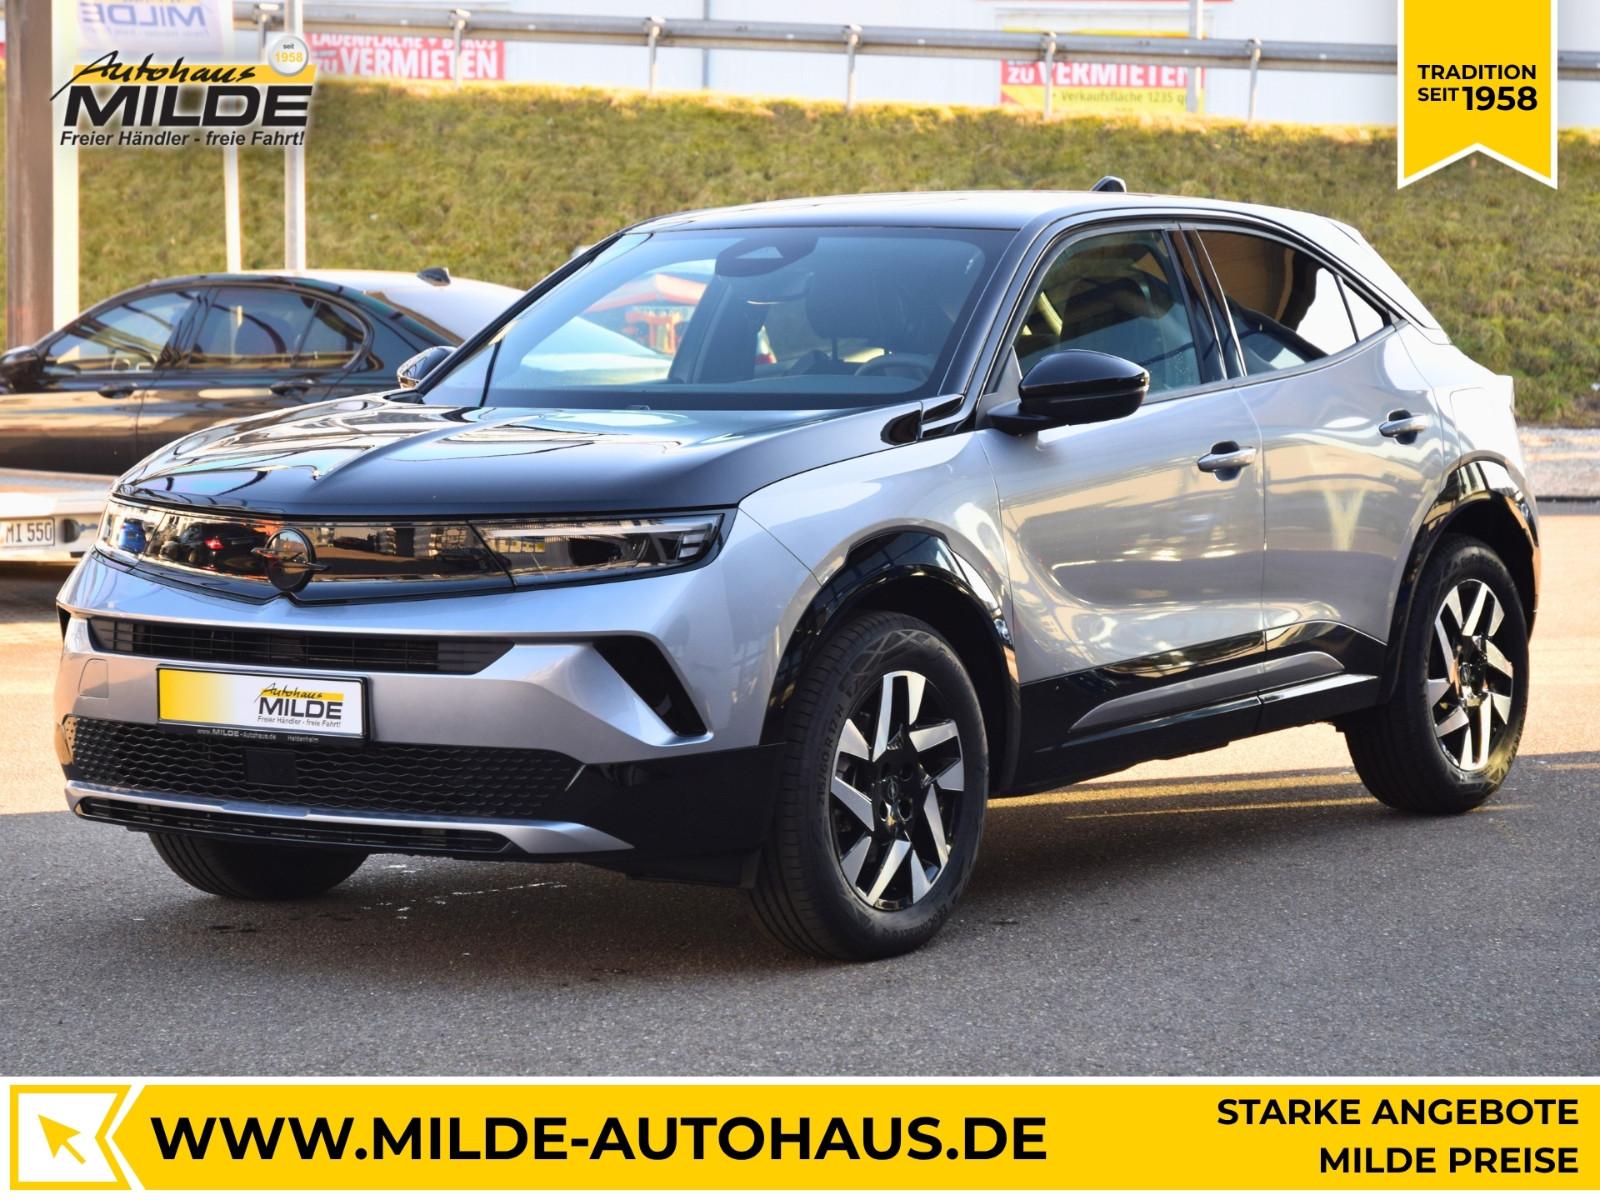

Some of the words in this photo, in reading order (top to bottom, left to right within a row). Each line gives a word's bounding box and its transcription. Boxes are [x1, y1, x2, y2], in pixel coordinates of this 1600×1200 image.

[340, 47, 498, 79] VERMIETEN
[27, 522, 52, 542] 550
[254, 682, 323, 703] Autohaus
[259, 696, 343, 720] MILDE
[257, 715, 276, 723] Freier
[277, 716, 301, 725] Händler
[306, 718, 320, 726] freie
[321, 719, 341, 728] Fahrt!
